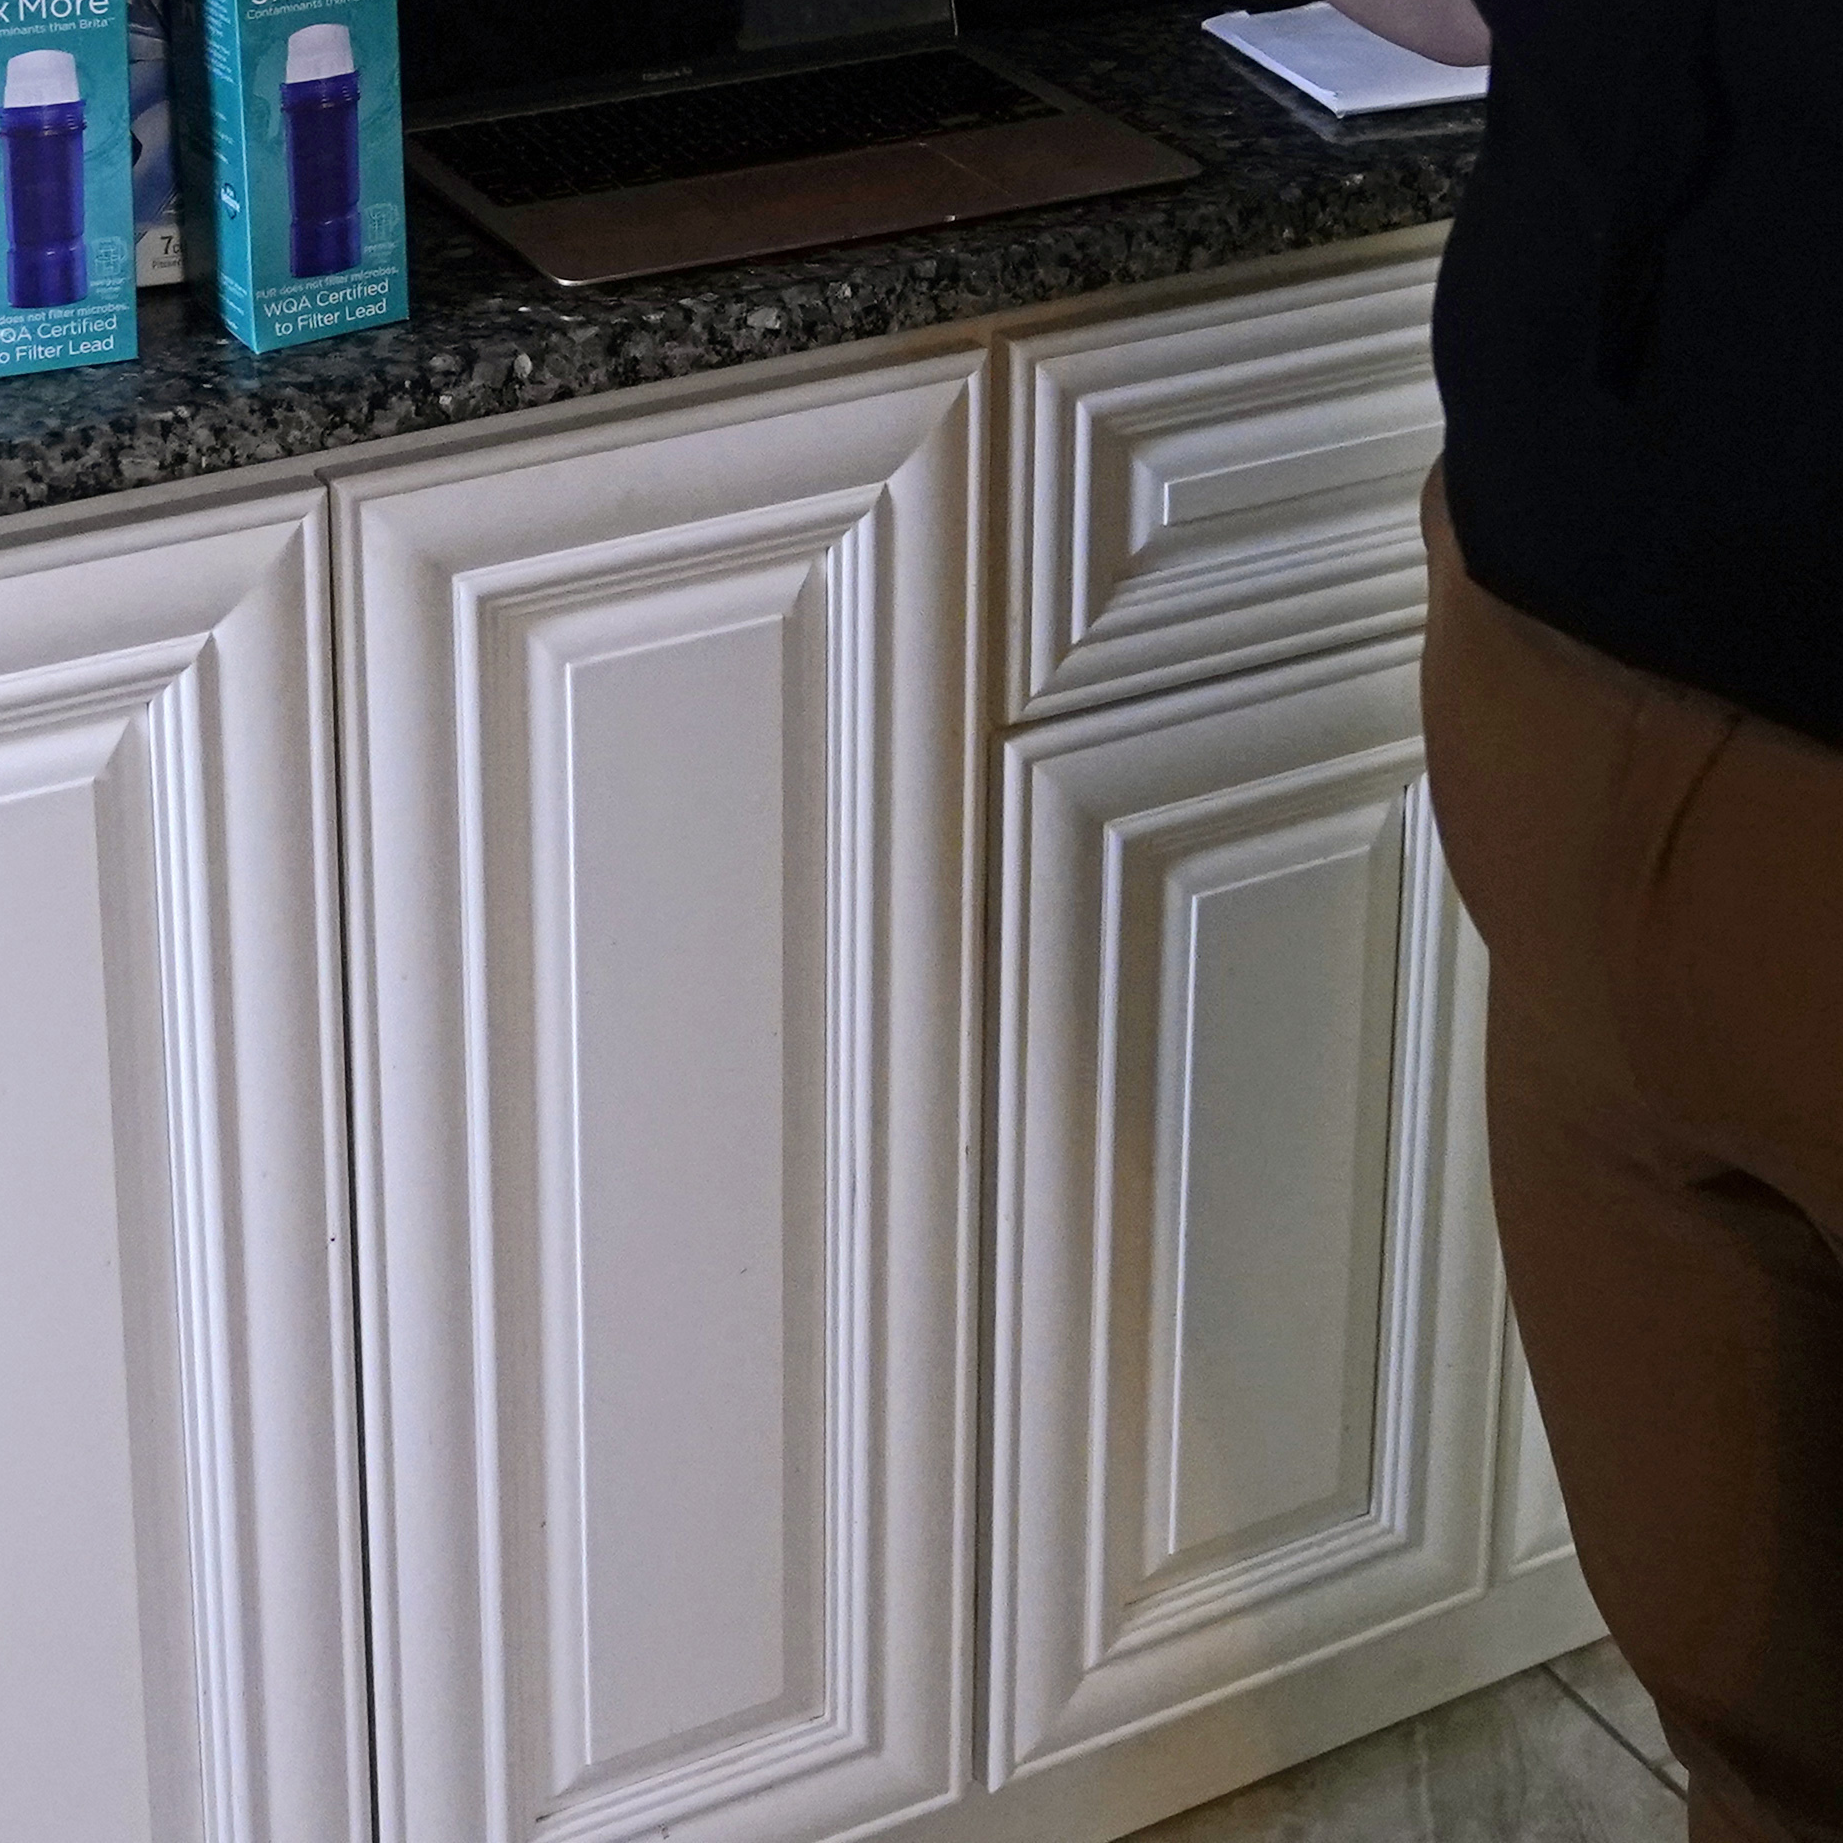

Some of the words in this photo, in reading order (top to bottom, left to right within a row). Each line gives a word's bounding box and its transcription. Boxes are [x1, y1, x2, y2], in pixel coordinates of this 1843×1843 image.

[247, 0, 323, 20] Contaminants
[49, 21, 76, 32] than
[160, 235, 174, 255] 7
[263, 296, 312, 318] WQA
[316, 278, 389, 306] Certified
[26, 312, 46, 322] not
[48, 309, 75, 320] filter
[37, 314, 117, 339] Certified
[275, 321, 293, 336] to
[297, 311, 340, 331] Filter
[345, 298, 387, 321] Lead
[16, 341, 63, 362] Filter
[68, 335, 114, 356] Lead
